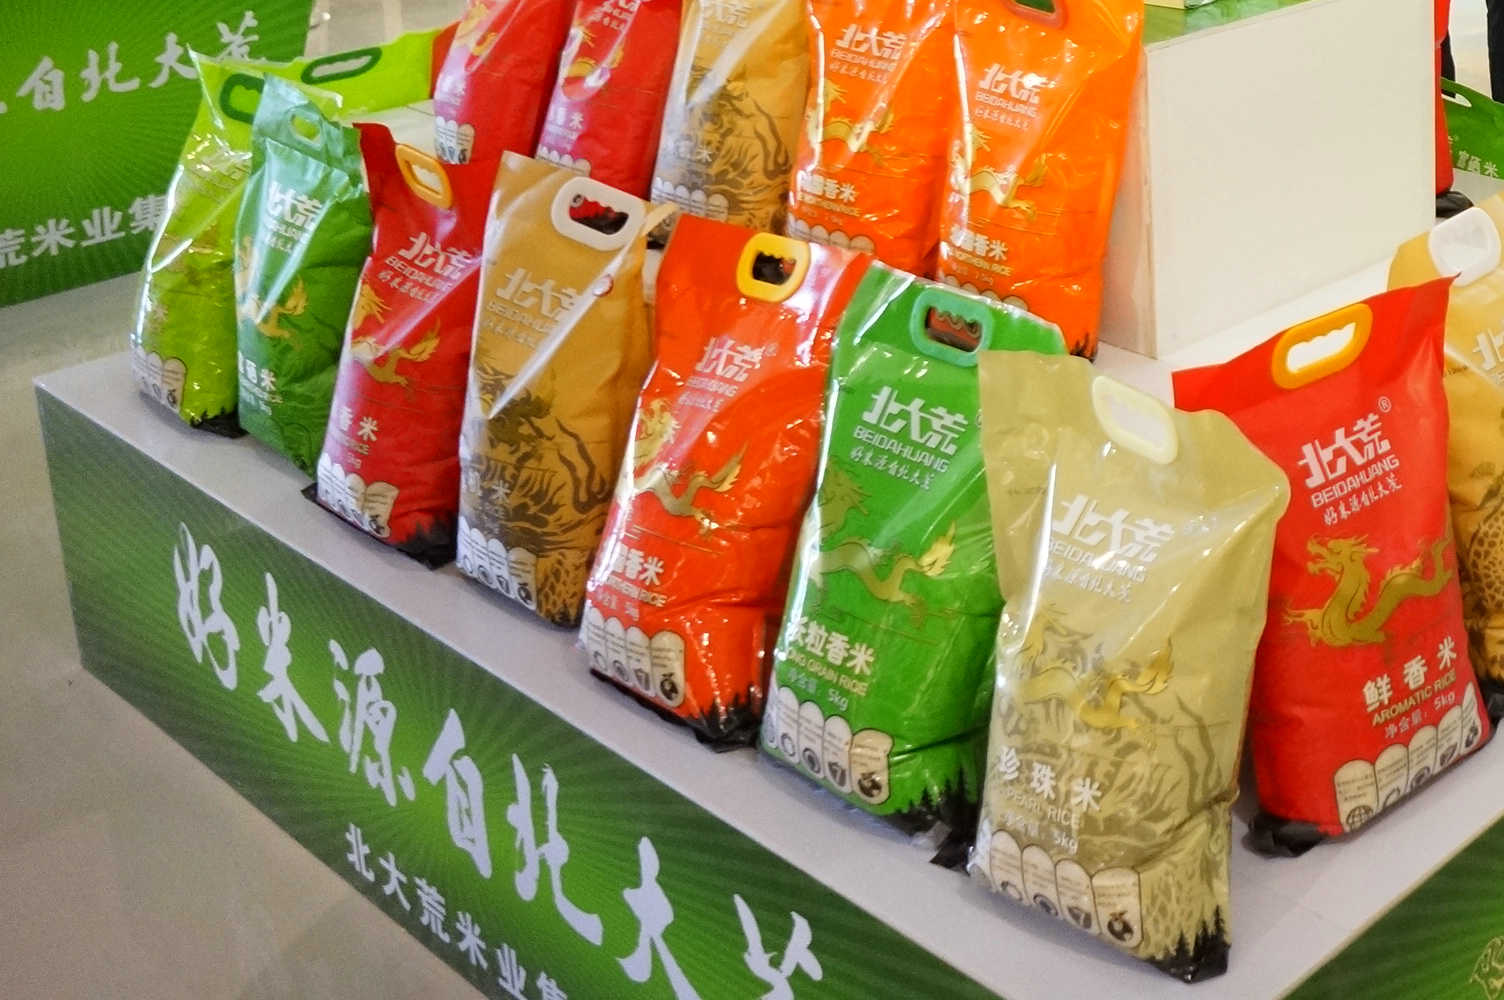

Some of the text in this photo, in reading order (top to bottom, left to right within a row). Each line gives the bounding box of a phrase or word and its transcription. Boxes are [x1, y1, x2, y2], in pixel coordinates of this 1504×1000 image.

[835, 23, 907, 61] 北大荒
[696, 336, 765, 382] 北大荒
[862, 386, 968, 455] 北大荒
[853, 425, 951, 472] BEIDAHUANG
[1298, 413, 1391, 488] 北大荒
[1311, 454, 1400, 508] BEIDAHUANG
[1052, 493, 1176, 563] 北大荒
[1363, 636, 1457, 713] 鲜香米
[1372, 686, 1433, 727] AROMATIC
[1047, 806, 1081, 827] RICE
